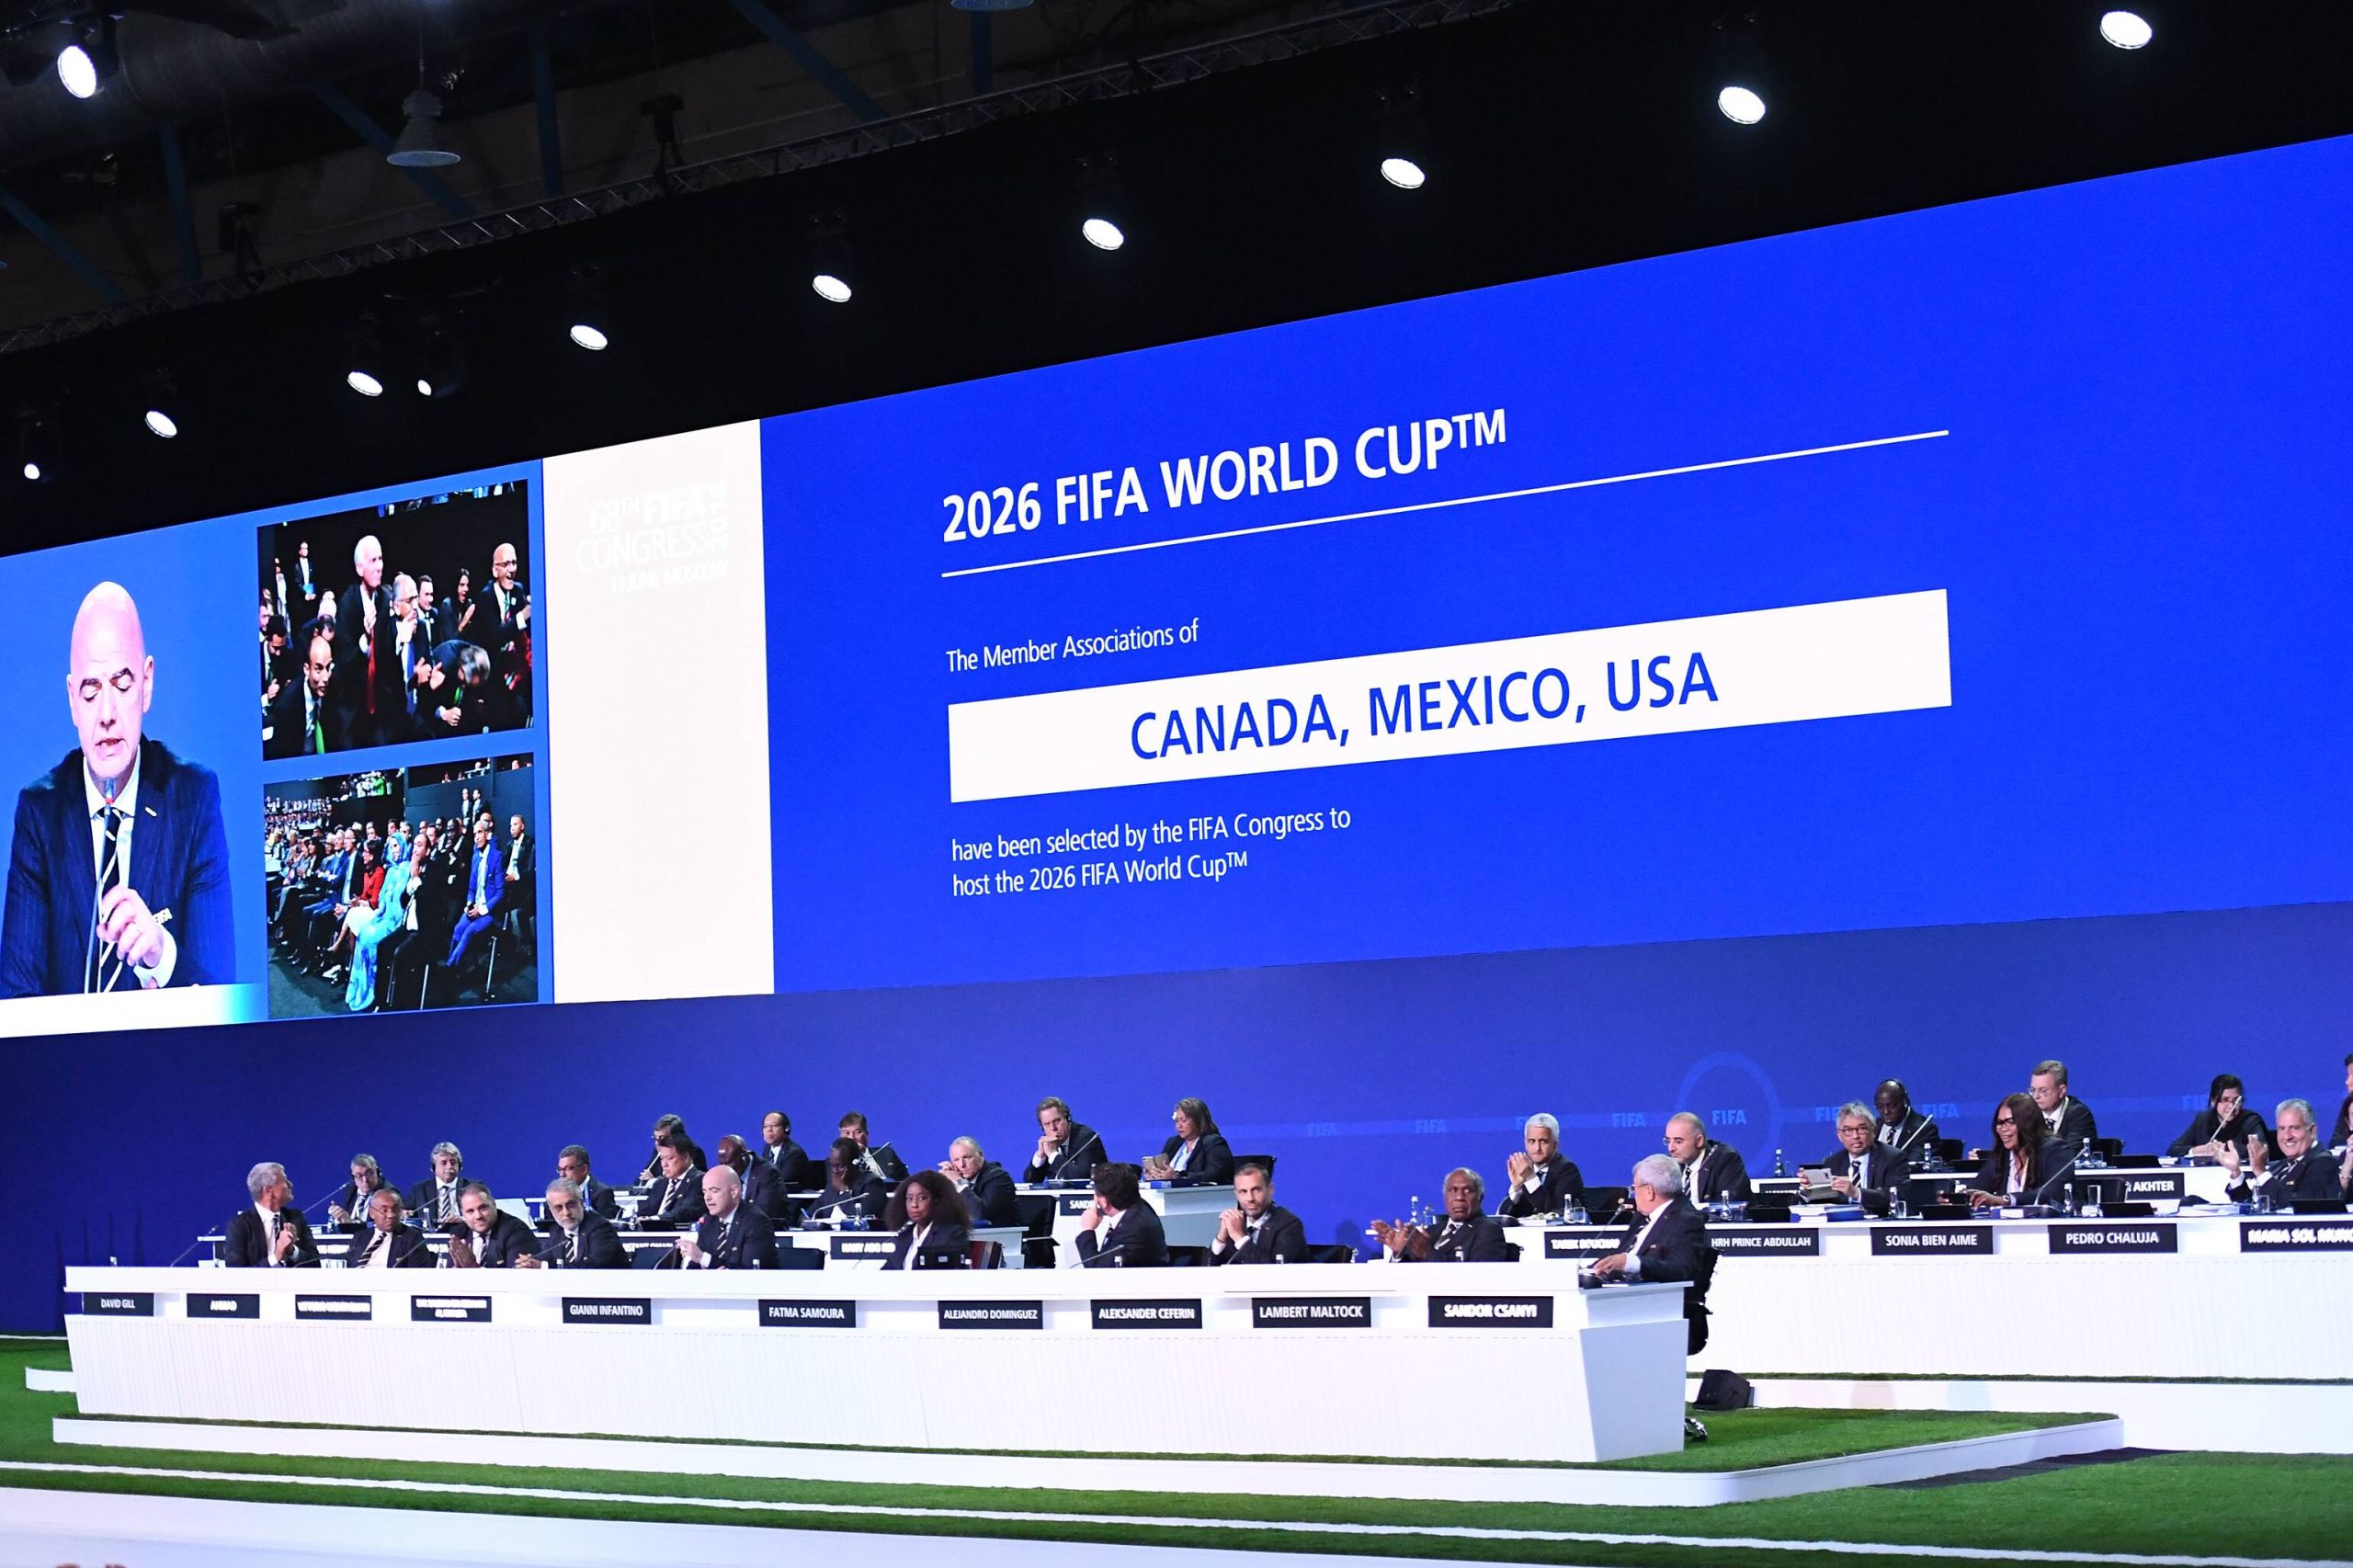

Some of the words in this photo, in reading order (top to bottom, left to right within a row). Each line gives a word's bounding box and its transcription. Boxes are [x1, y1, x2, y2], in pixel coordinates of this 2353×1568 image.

[943, 482, 1041, 542] 2026
[1055, 466, 1149, 525] FIFA
[1160, 437, 1338, 508] WORLD
[642, 485, 707, 525] FIFA
[575, 520, 709, 573] CONGRESS
[664, 558, 728, 585] MOSCOW
[946, 648, 978, 672] The
[983, 640, 1057, 668] Member
[1063, 629, 1174, 659] Associations
[1179, 617, 1199, 643] of
[1131, 693, 1349, 760] CANADA,
[1369, 667, 1587, 736] MEXICO,
[1607, 652, 1719, 711] USA
[951, 838, 993, 862] have
[997, 834, 1041, 858] been
[1046, 824, 1120, 854] selected
[1124, 824, 1147, 851] by
[1151, 819, 1183, 845] the
[1188, 815, 1229, 841] FIFA
[1233, 810, 1324, 841] Congress
[1329, 806, 1351, 829] to
[952, 873, 992, 897] host
[995, 869, 1024, 893] the
[1029, 865, 1076, 892] 2026
[1081, 862, 1120, 888] FIFA
[1123, 856, 1182, 884] World
[1611, 1112, 1646, 1128] FIFA
[1711, 1109, 1747, 1125] FIFA
[1307, 1121, 1338, 1136] FIFA
[1415, 1119, 1446, 1133] FIFA
[2132, 1180, 2175, 1192] AKHTER
[1711, 1237, 1730, 1248] HRH
[1732, 1237, 1762, 1247] PRINCE
[1763, 1236, 1811, 1247] ABDULLAH
[1885, 1234, 1920, 1246] SONIA
[1922, 1234, 1946, 1246] BIEN
[1949, 1233, 1977, 1245] AIME
[2065, 1233, 2104, 1244] PEDRO
[2106, 1232, 2159, 1244] CHALUJA
[2248, 1228, 2290, 1244] MARIA
[2291, 1228, 2316, 1243] SOL
[101, 1299, 120, 1309] DAVID
[122, 1299, 135, 1309] GILL
[570, 1304, 598, 1316] GIANNI
[599, 1305, 643, 1316] INFANTINO
[1444, 1304, 1493, 1318] SANDOR
[1494, 1304, 1537, 1318] CSANYI
[768, 1306, 798, 1318] FATMA
[800, 1307, 845, 1319] SAMOURA
[943, 1309, 988, 1320] ALEJANDRO
[990, 1309, 1038, 1320] DOMINGUEZ
[1098, 1308, 1156, 1320] ALEKSANDER
[1158, 1308, 1195, 1320] CEFERIN
[1259, 1306, 1308, 1318] LAMBERT
[1310, 1305, 1363, 1318] MALTOCK
